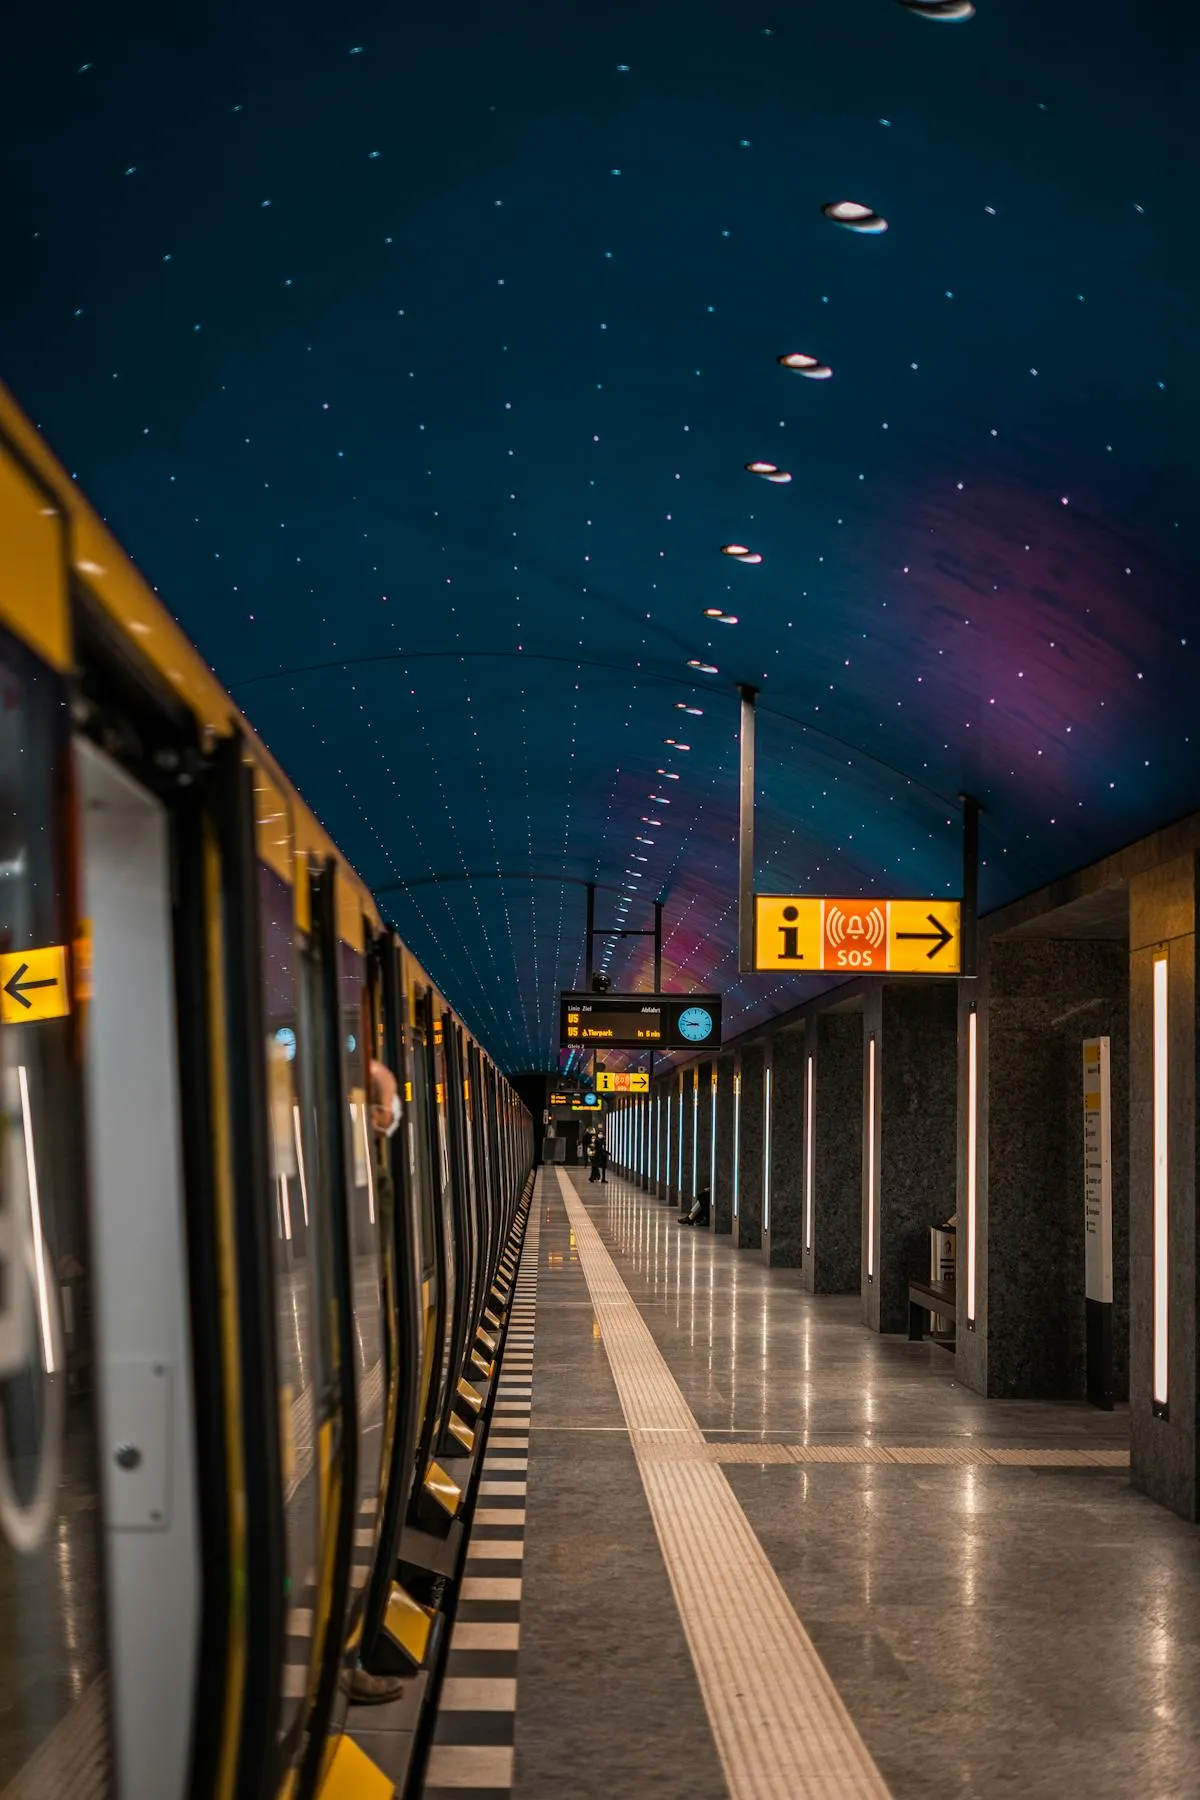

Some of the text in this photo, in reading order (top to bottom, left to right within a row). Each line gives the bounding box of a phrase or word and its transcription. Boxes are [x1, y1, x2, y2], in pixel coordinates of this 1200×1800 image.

[837, 950, 873, 967] SOS
[568, 1013, 579, 1024] U5
[568, 1027, 613, 1037] U5 Tierpark
